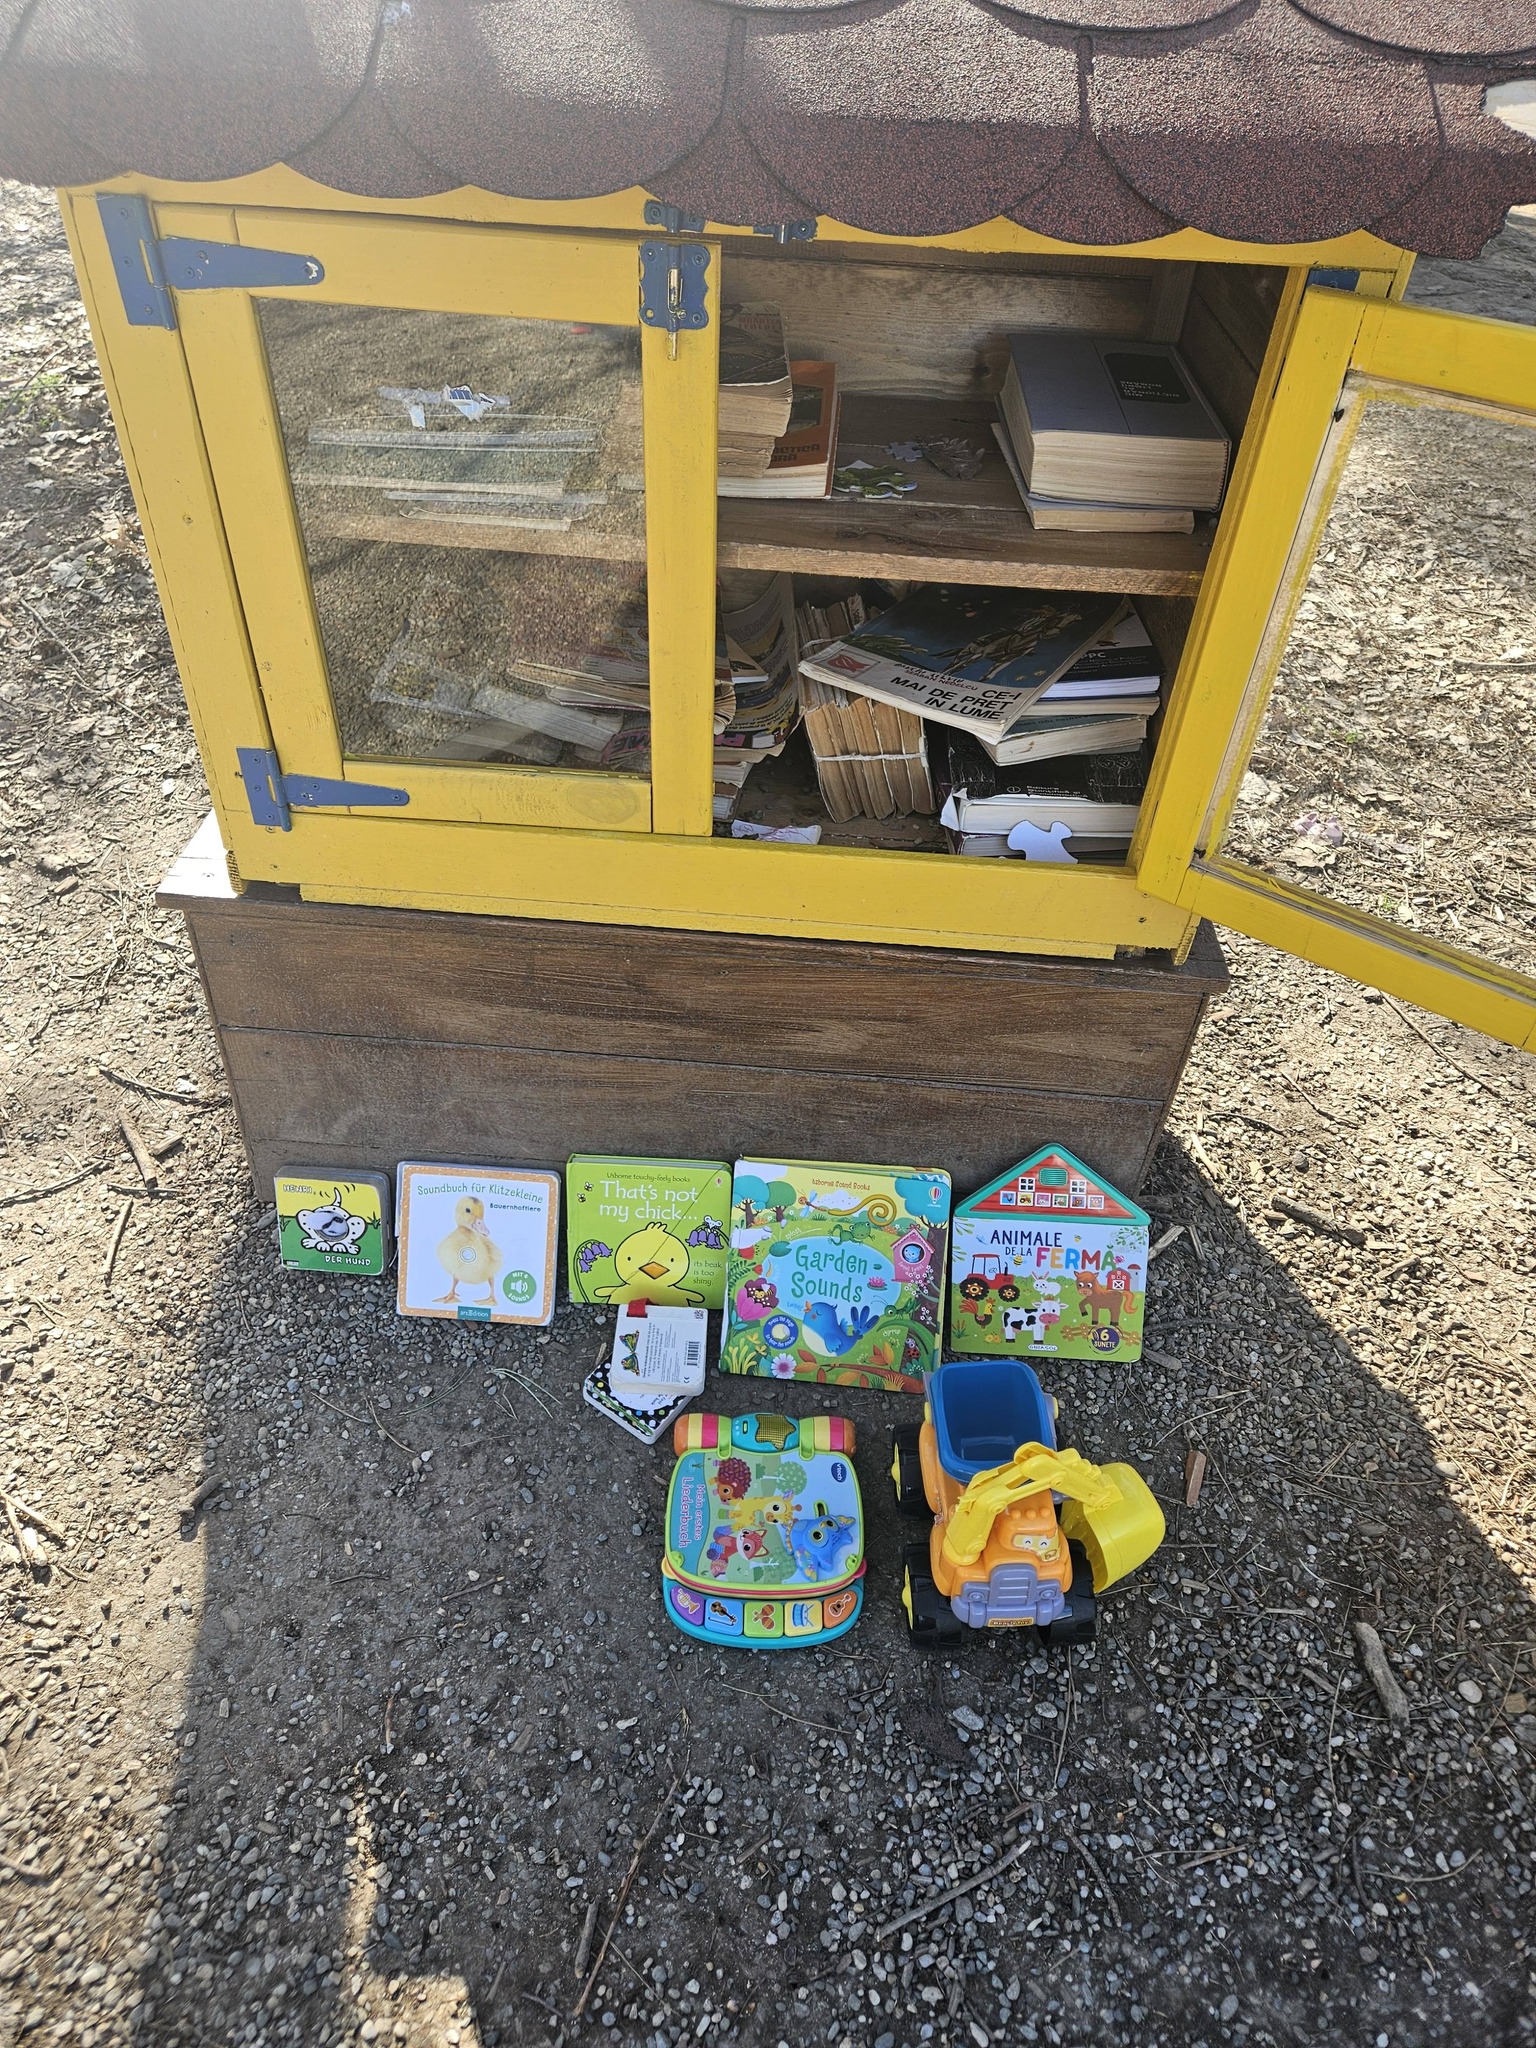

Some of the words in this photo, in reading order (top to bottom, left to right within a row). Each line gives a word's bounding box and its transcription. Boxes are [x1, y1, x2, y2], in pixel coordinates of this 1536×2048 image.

[890, 676, 927, 692] MAI
[928, 688, 958, 700] DE
[960, 695, 1014, 710] PRET
[981, 689, 1022, 700] CE-I
[924, 696, 946, 710] IN
[948, 704, 1004, 720] LUME
[606, 1172, 632, 1180] Usborne
[633, 1174, 672, 1182] touchy-feely
[672, 1174, 690, 1183] books
[812, 1178, 834, 1188] Usborne
[834, 1180, 852, 1190] Sound
[852, 1182, 870, 1191] Books
[417, 1182, 468, 1196] Soundbuch
[471, 1182, 486, 1194] für
[488, 1184, 544, 1204] Klitzekleine
[600, 1180, 658, 1200] That's
[665, 1186, 698, 1203] not
[489, 1202, 542, 1212] Bauernhoftiere
[600, 1204, 630, 1223] my
[634, 1201, 698, 1221] chick...
[990, 1230, 1063, 1248] ANIMALE
[324, 1255, 342, 1264] DER
[345, 1258, 372, 1266] HUND
[795, 1244, 868, 1276] Garden
[1005, 1246, 1015, 1256] DE
[1020, 1248, 1033, 1256] LA
[704, 1260, 722, 1269] beak
[790, 1271, 863, 1302] Sounds
[1100, 1328, 1110, 1341] 6
[1094, 1340, 1116, 1350] SUNETE
[697, 1484, 705, 1506] Mein
[678, 1476, 694, 1548] Liederbuch
[694, 1508, 705, 1541] erstes
